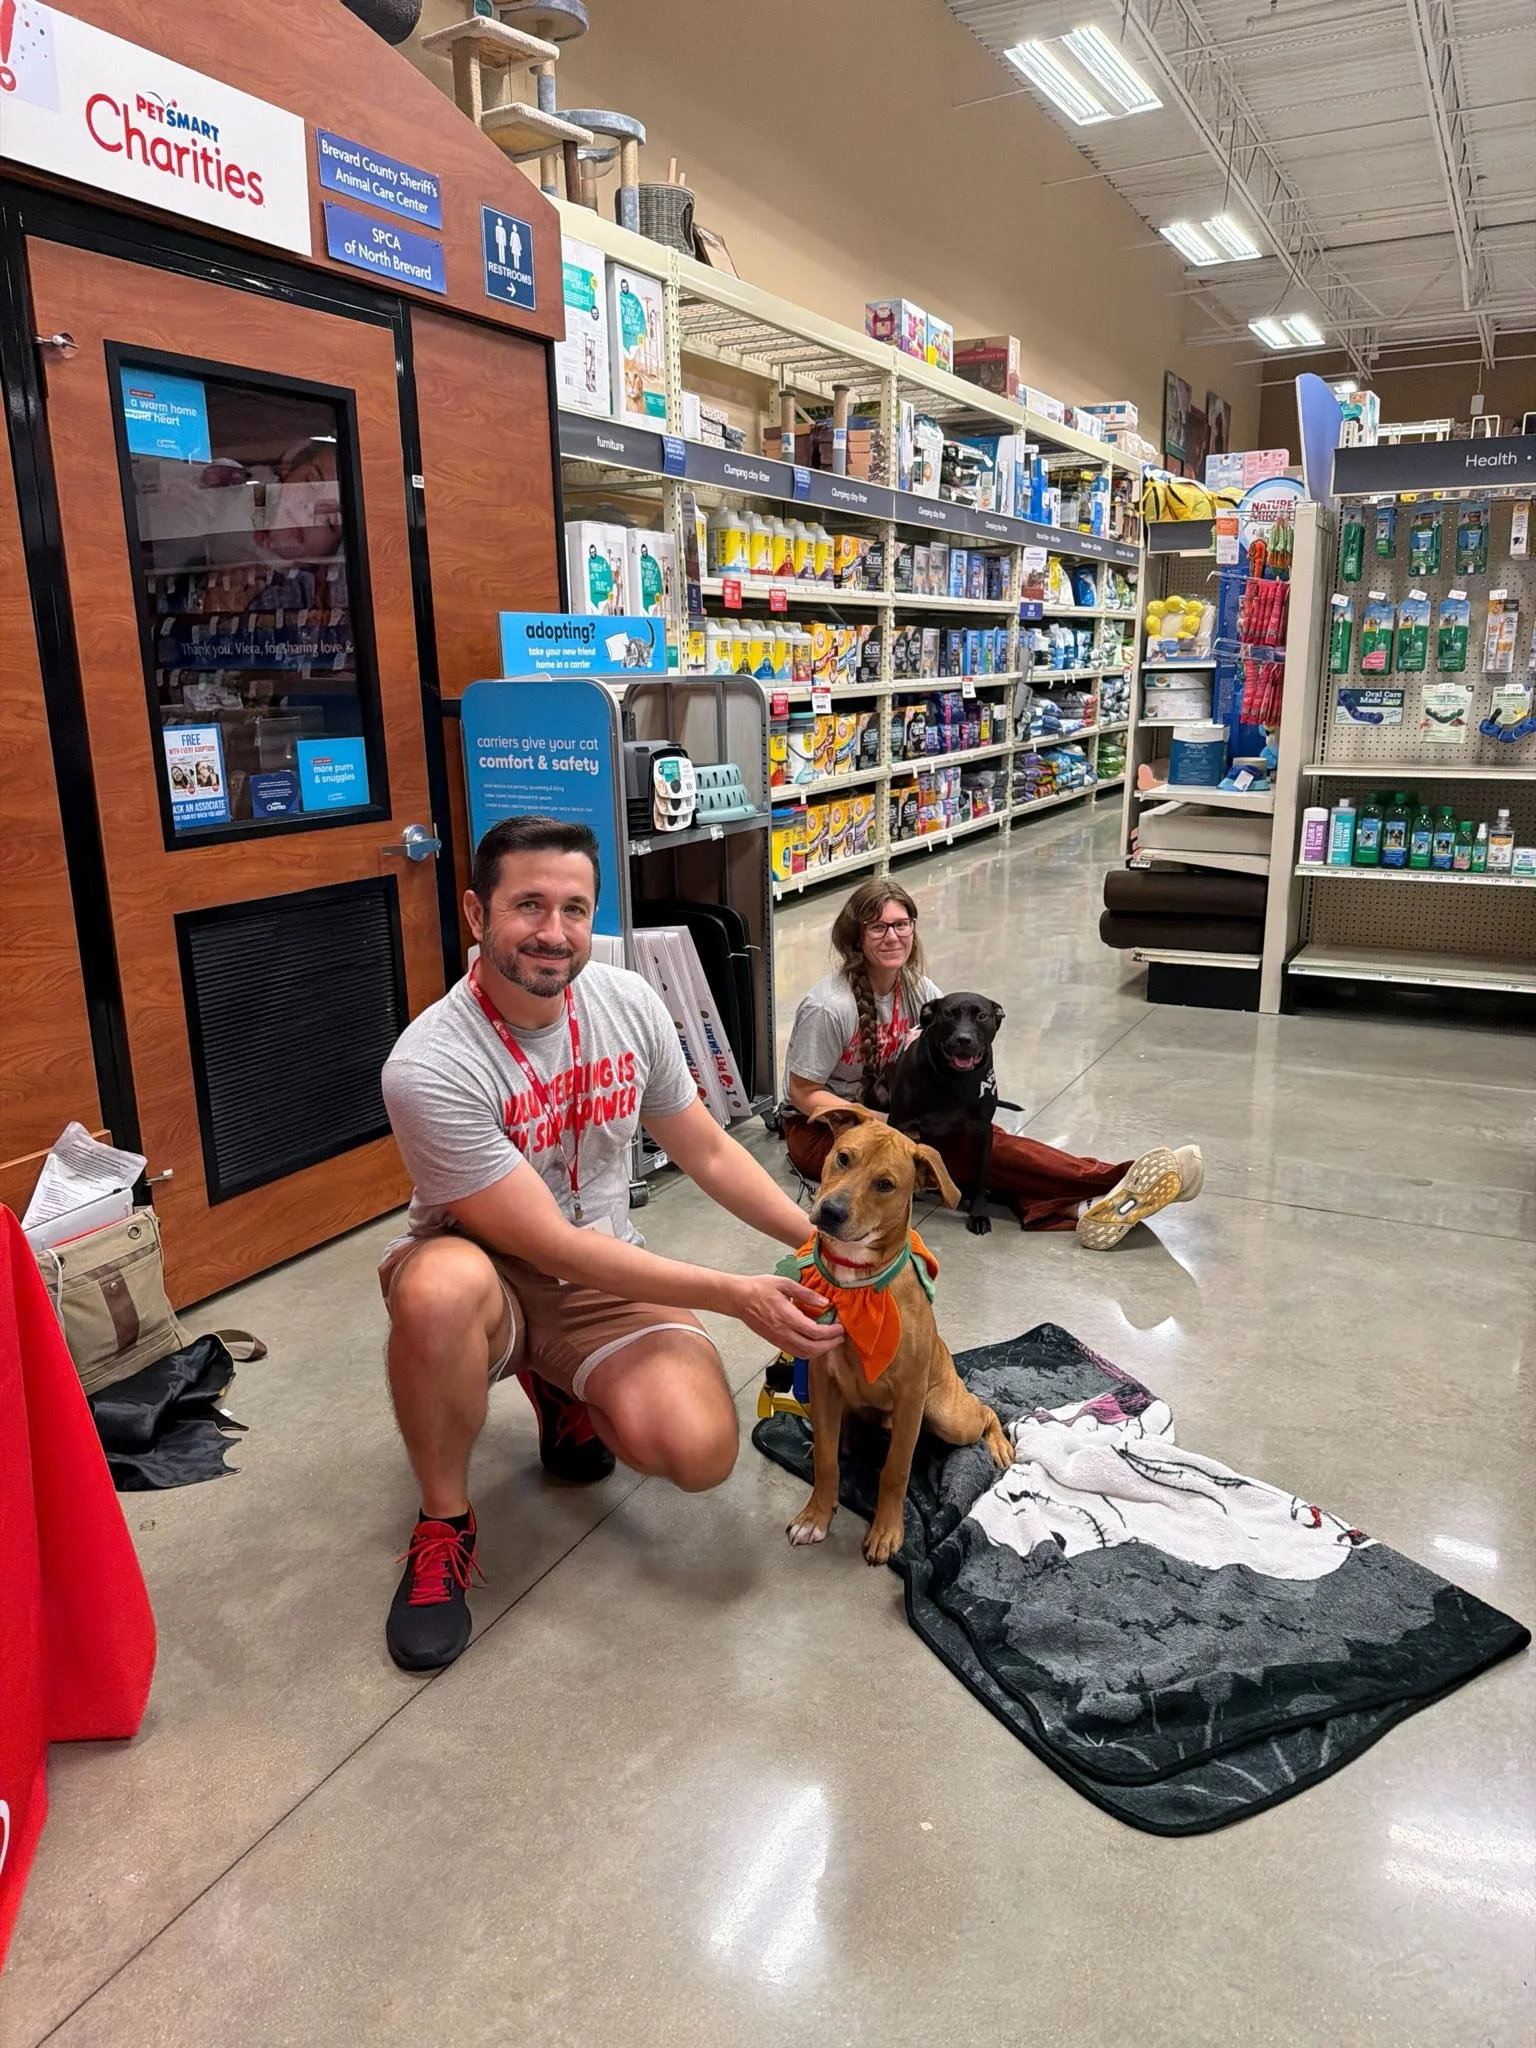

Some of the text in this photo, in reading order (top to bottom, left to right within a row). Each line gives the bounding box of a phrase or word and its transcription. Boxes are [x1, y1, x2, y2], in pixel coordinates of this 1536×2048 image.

[136, 93, 220, 143] PETSMART
[85, 93, 264, 206] Charities
[321, 139, 438, 198] Brevard County Sheriff's
[335, 167, 429, 214] Animal Care Center
[371, 227, 402, 251] SPCA
[344, 240, 432, 281] of North Brevard
[487, 261, 533, 286] RESTROOMS
[130, 398, 198, 417] a warm home
[153, 413, 180, 427] heart
[597, 436, 625, 452] furniture
[1465, 451, 1518, 468] Health
[724, 463, 748, 481] Clumping
[525, 620, 597, 644] adopting?
[181, 643, 211, 656] Thank
[264, 641, 281, 654] for
[281, 640, 318, 657] sharing
[320, 640, 343, 653] love
[345, 641, 355, 653] &
[528, 646, 596, 658] take your new friend
[535, 660, 555, 669] home
[556, 660, 563, 668] in
[570, 660, 591, 669] carrier
[1359, 696, 1402, 706] Made Easy
[181, 733, 201, 746] FREE
[477, 735, 599, 753] carriers give your cat
[313, 763, 354, 774] more purrs
[479, 754, 600, 776] comfort & safety
[314, 773, 355, 784] & snuggles
[173, 800, 226, 814] ASK AN ASSOCIATE
[1306, 828, 1315, 847] WIPES
[1315, 825, 1324, 847] DENTAL
[1342, 829, 1351, 849] WATER
[704, 1022, 727, 1072] PETSMART
[618, 1052, 635, 1083] IS
